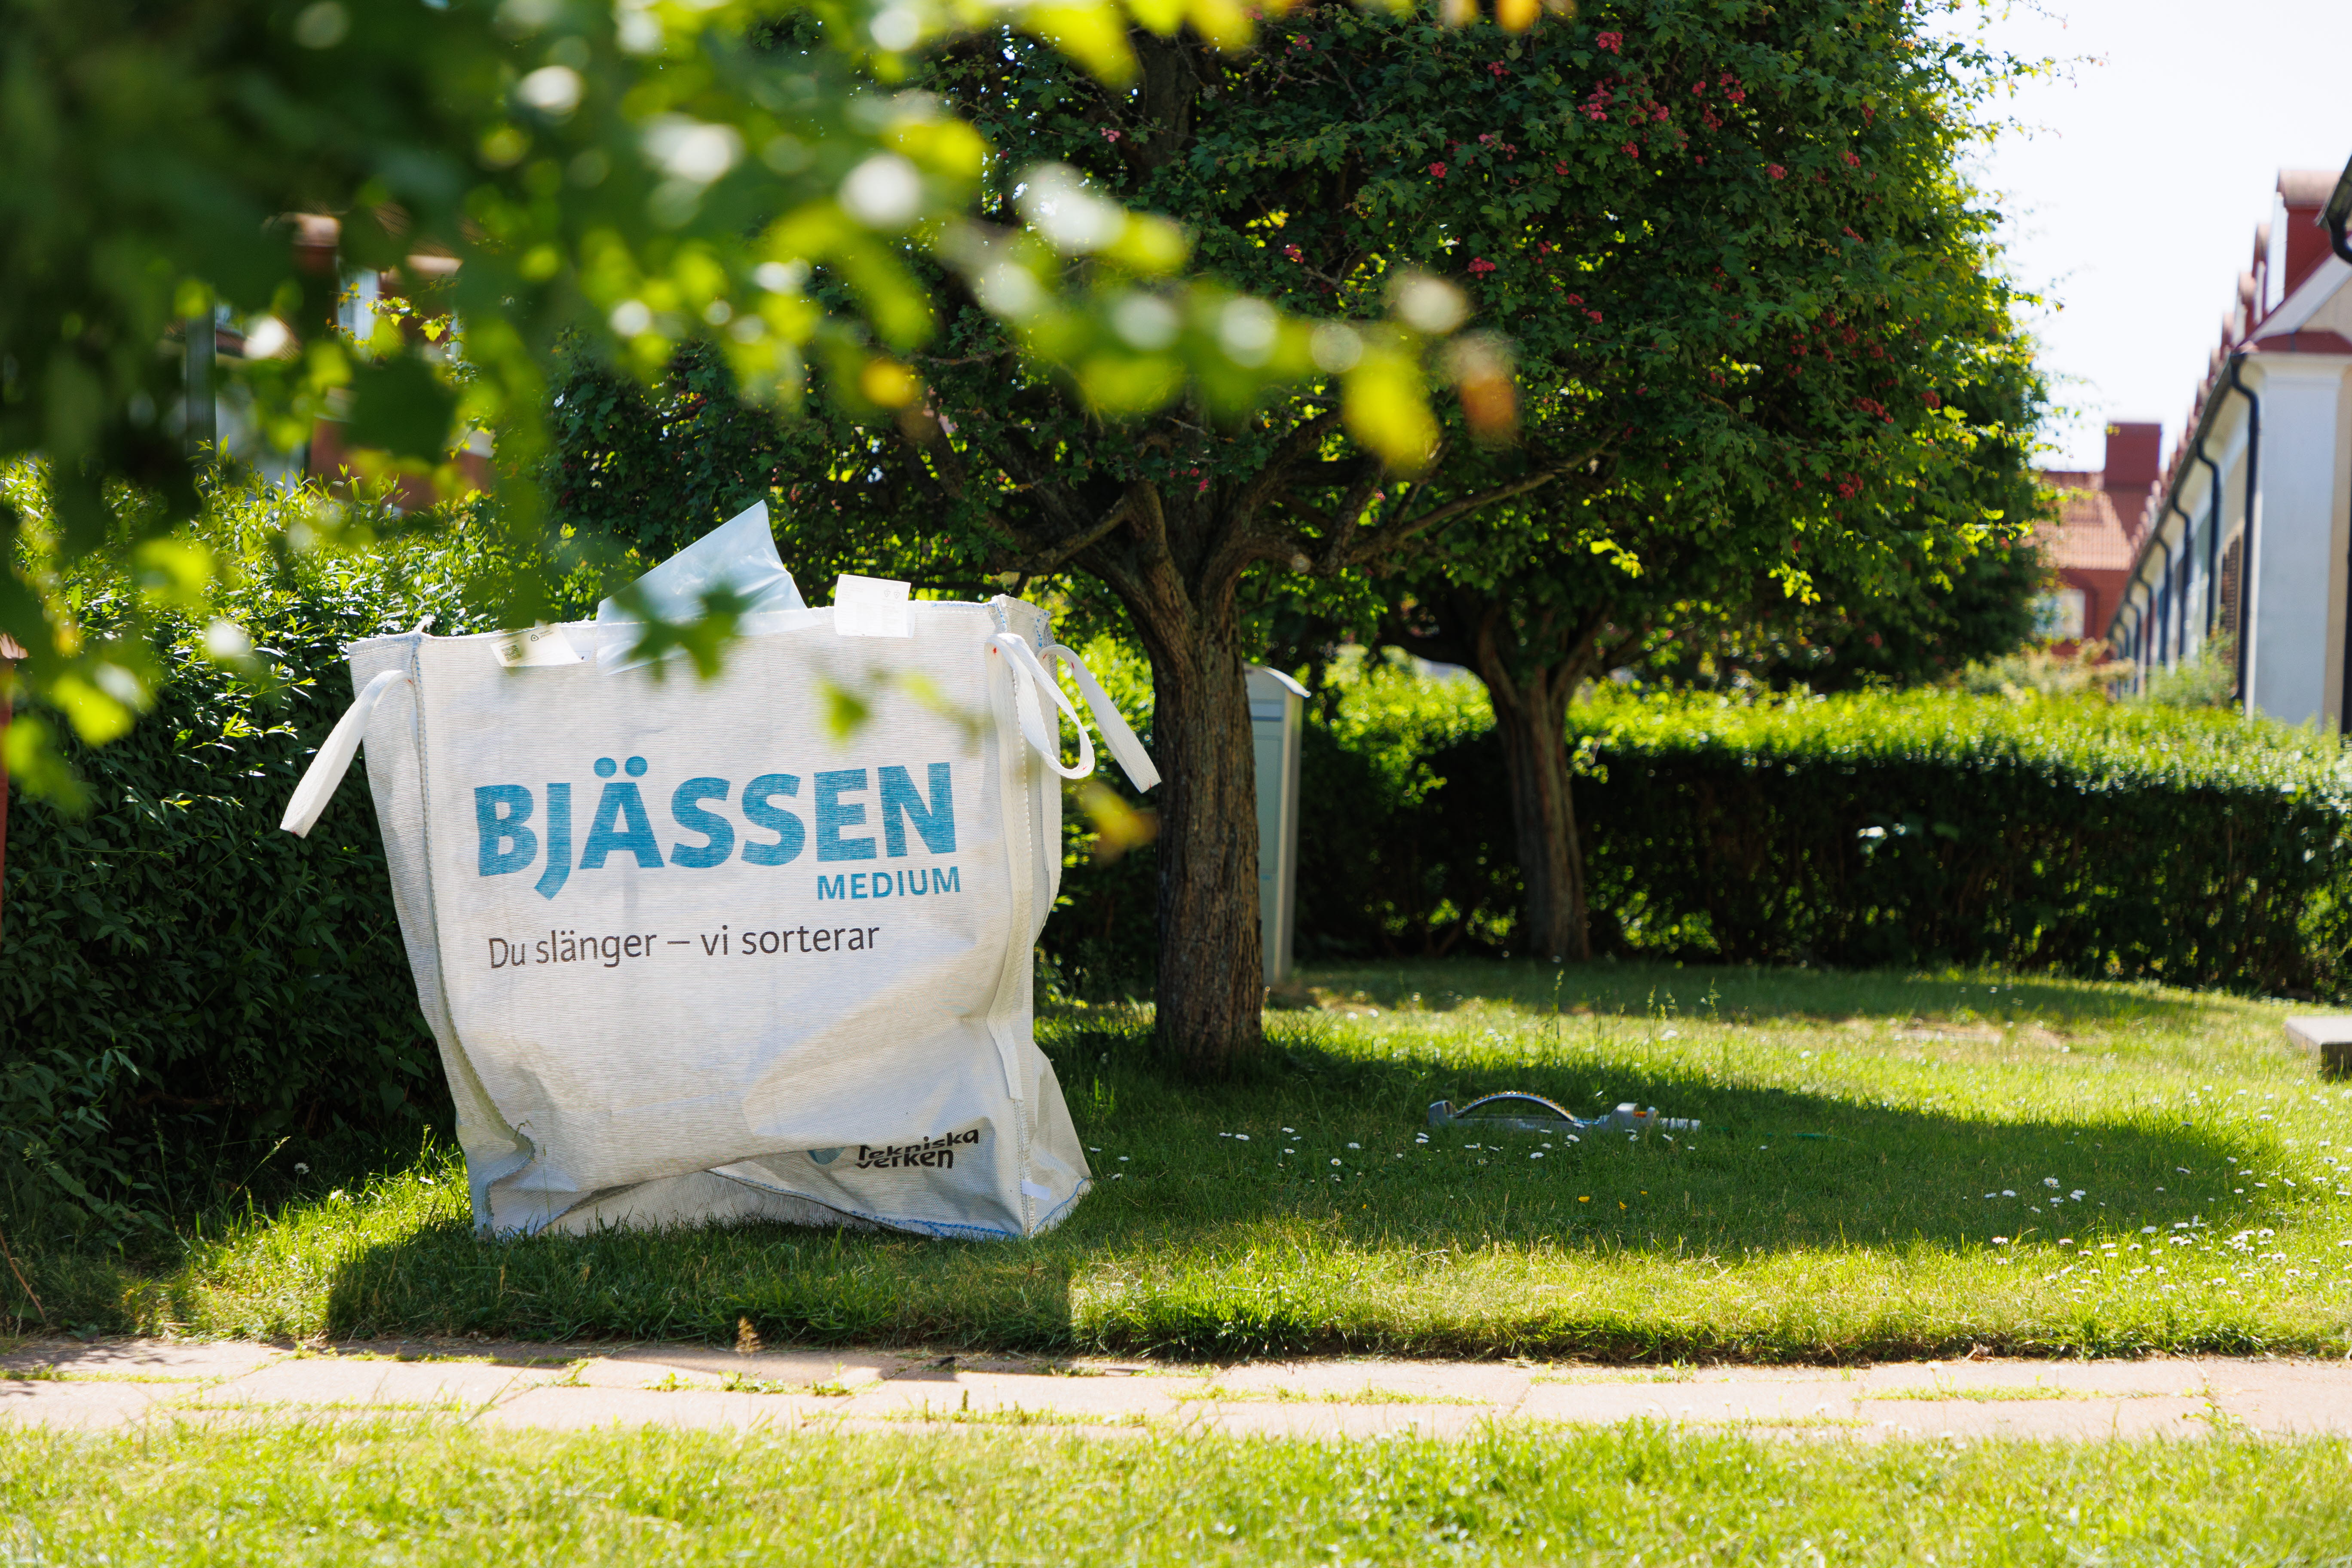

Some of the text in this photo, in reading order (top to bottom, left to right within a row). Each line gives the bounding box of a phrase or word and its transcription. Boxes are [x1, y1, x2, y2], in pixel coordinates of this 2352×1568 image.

[474, 756, 956, 900] BJÄSSEN
[817, 866, 961, 900] MEDIUM
[488, 937, 525, 968] Du
[536, 930, 657, 968] slänger
[701, 925, 729, 956] vi
[741, 925, 880, 955] sorterar
[855, 1149, 954, 1169] verken
[859, 1129, 979, 1161] Tekniska
